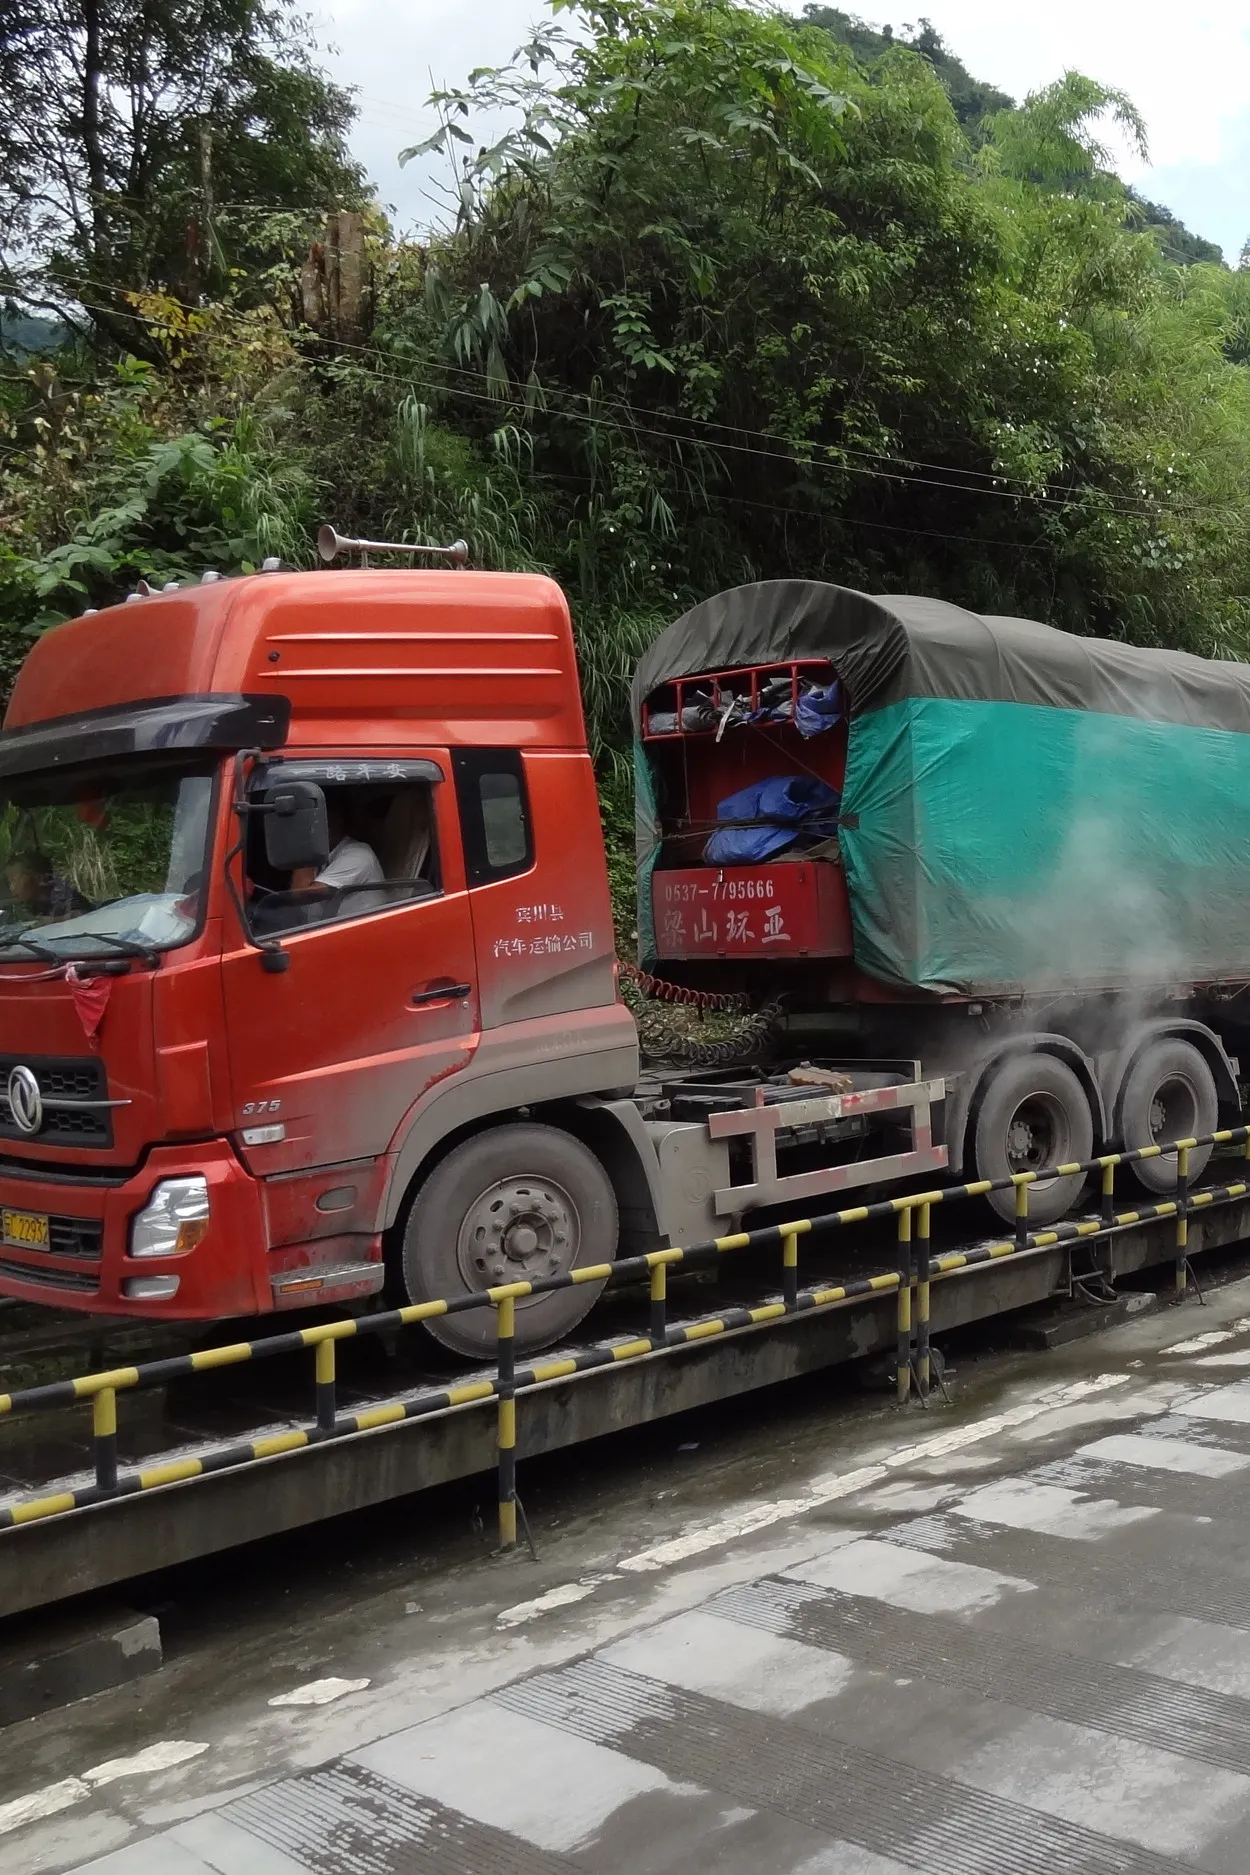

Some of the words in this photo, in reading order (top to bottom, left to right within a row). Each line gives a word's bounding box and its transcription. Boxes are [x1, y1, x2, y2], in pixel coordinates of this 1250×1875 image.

[665, 879, 774, 901] 0537-7795666
[662, 905, 791, 947] 梁山环亚
[493, 931, 593, 958] 汽车运输公司
[242, 1099, 282, 1115] 375
